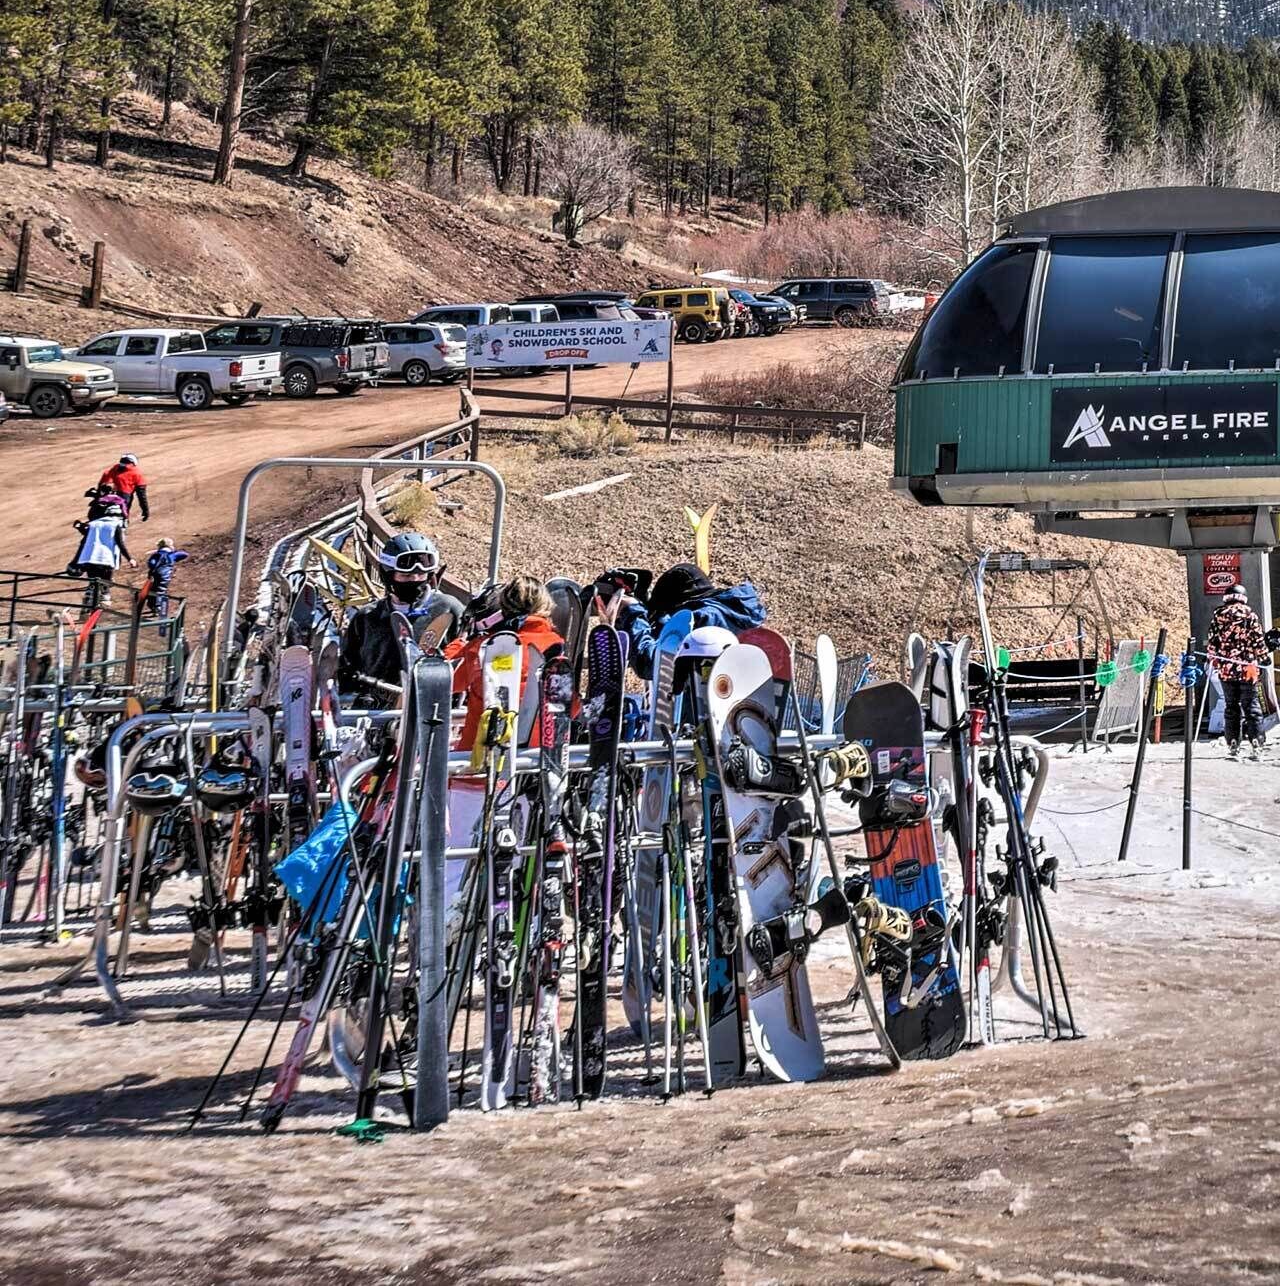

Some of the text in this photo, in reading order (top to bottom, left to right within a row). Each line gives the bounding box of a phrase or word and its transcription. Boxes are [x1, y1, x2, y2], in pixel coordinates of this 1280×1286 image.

[513, 326, 622, 338] CHILDREN'S SKI AND
[508, 336, 627, 348] SNOWBOARD SCHOOL
[1109, 411, 1269, 432] ANGEL FIRE
[1143, 432, 1241, 441] RESORT
